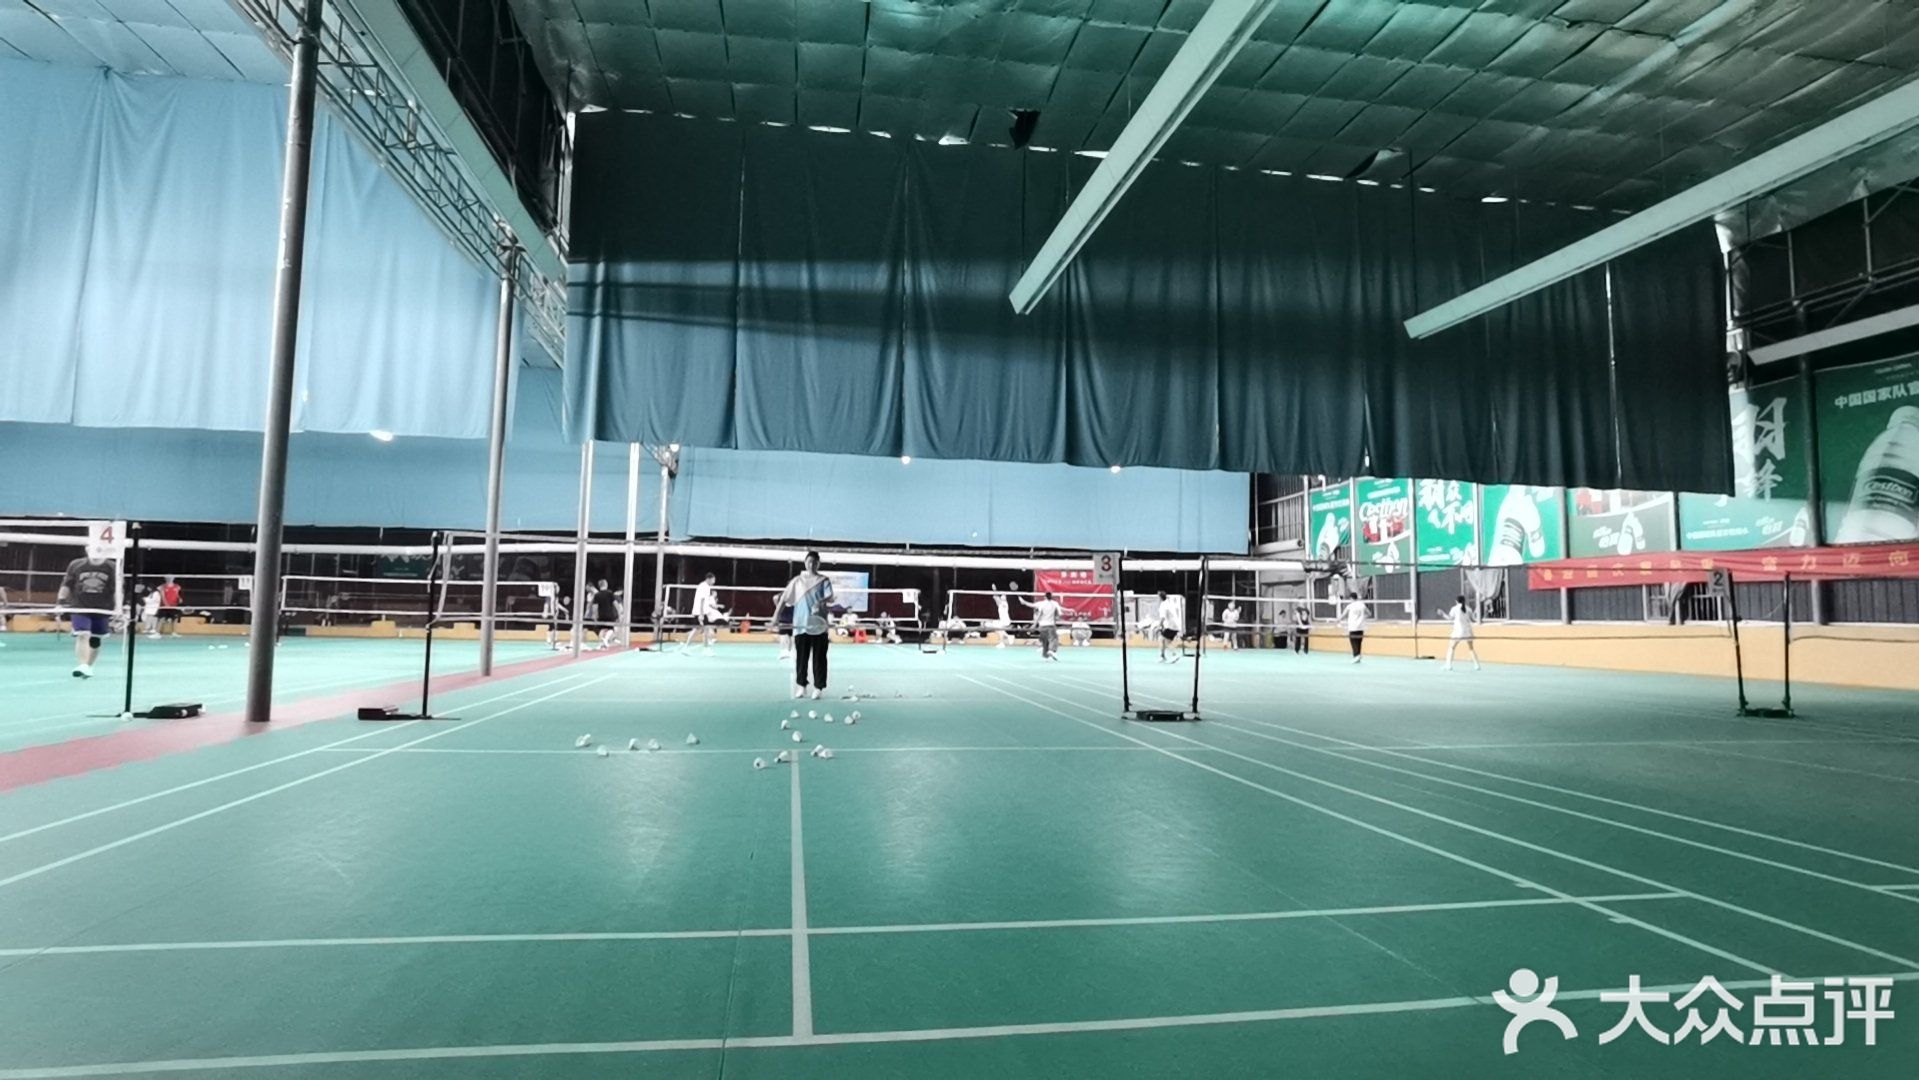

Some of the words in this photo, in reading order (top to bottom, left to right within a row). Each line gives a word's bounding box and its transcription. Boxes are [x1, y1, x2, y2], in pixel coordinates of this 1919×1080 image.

[99, 526, 115, 544] 4
[1101, 554, 1112, 572] 3
[1713, 570, 1724, 587] 2
